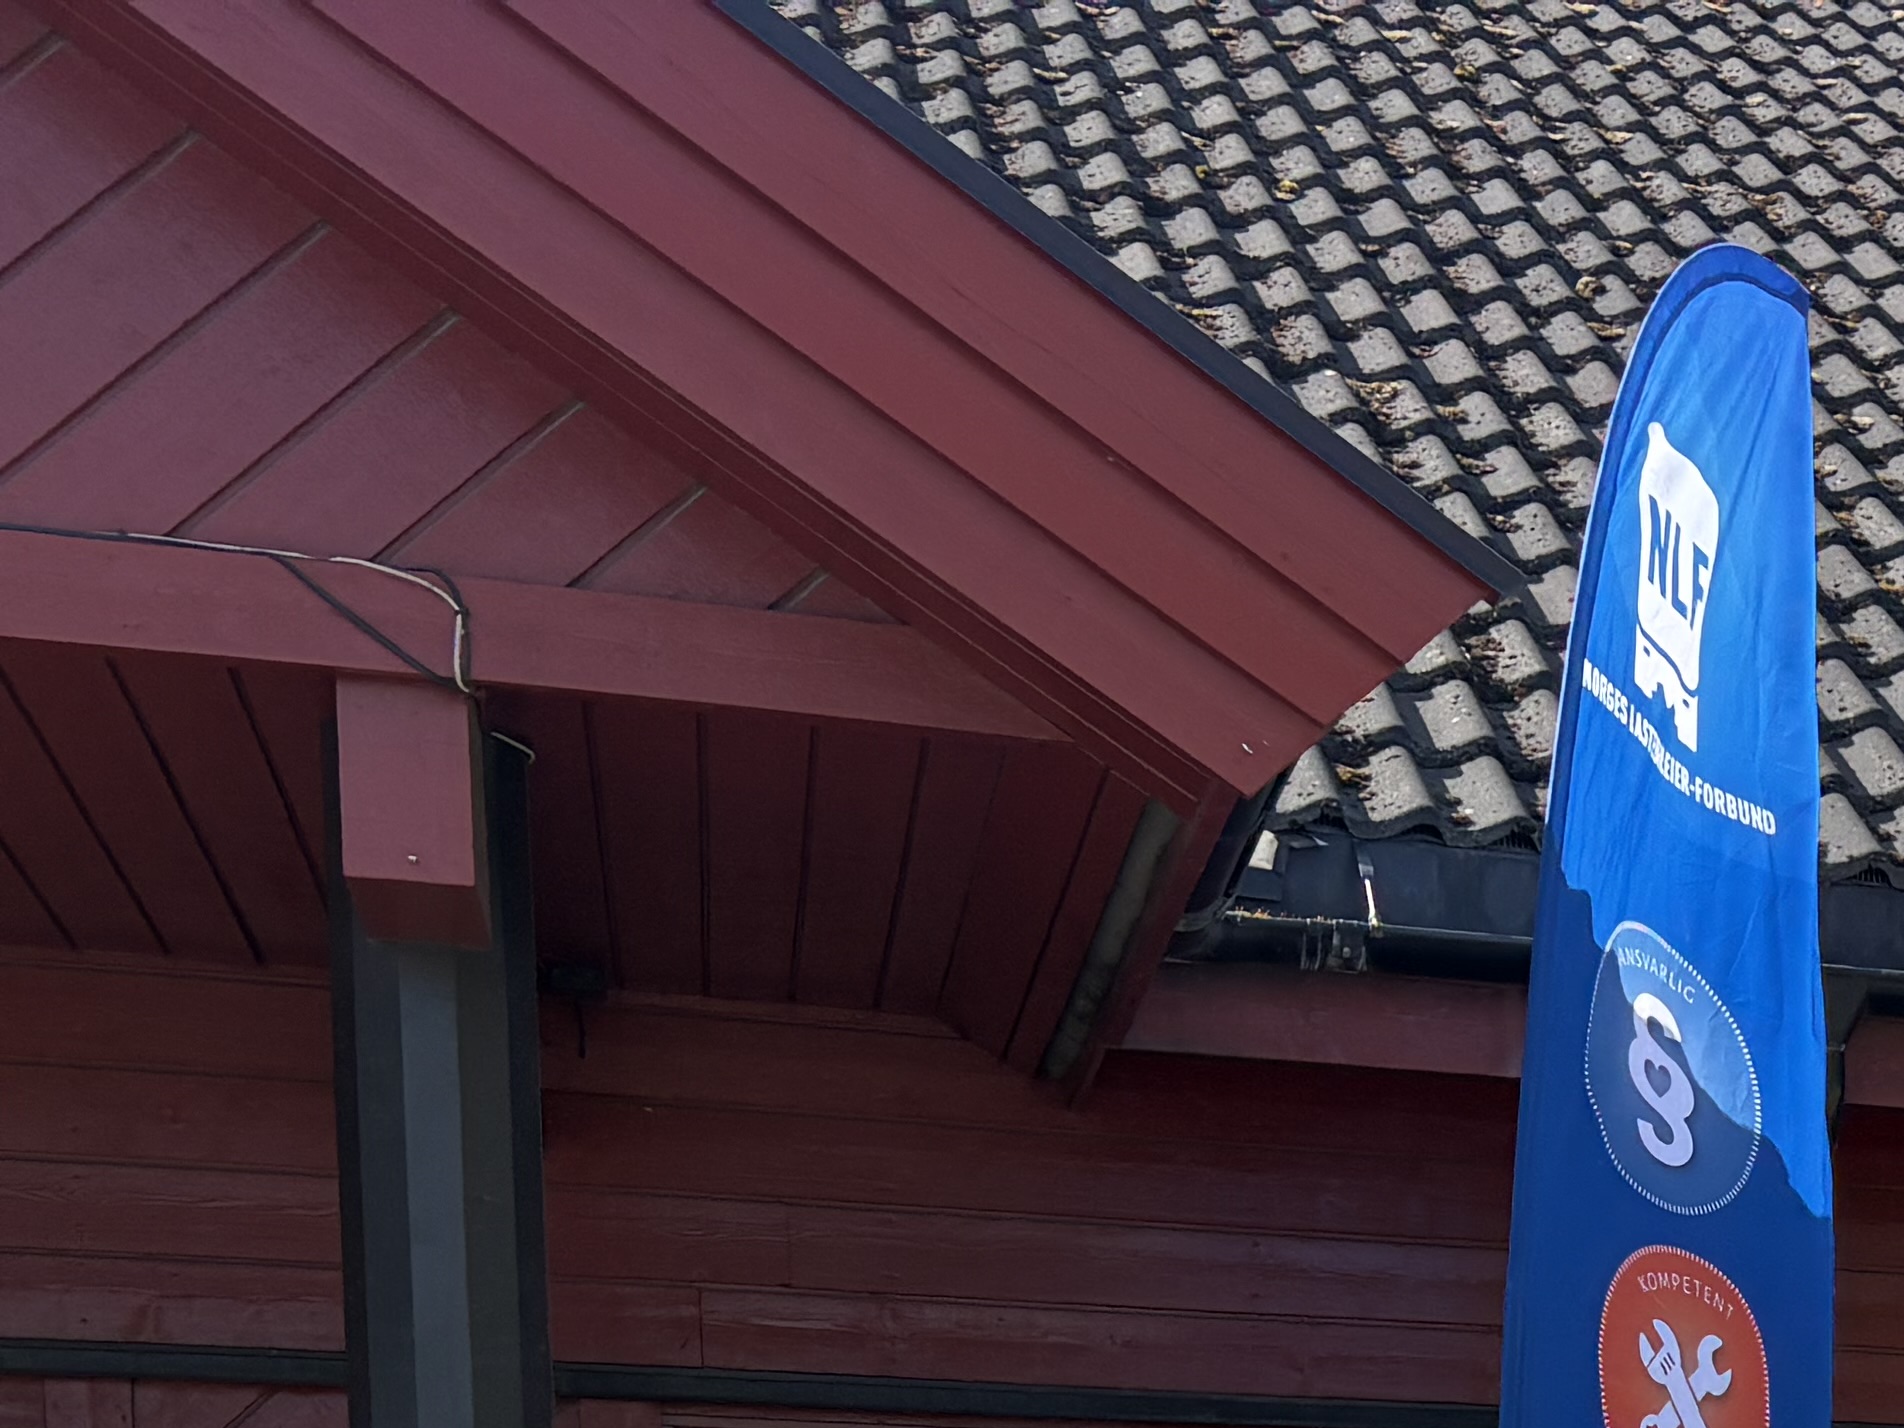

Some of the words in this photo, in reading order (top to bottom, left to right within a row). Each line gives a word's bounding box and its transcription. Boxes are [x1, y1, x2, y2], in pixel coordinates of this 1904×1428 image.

[1647, 493, 1710, 631] NLF
[1582, 657, 1628, 727] NORGES
[1618, 946, 1696, 1005] ANSVARLIG
[1637, 1271, 1734, 1320] KOMPETENT
